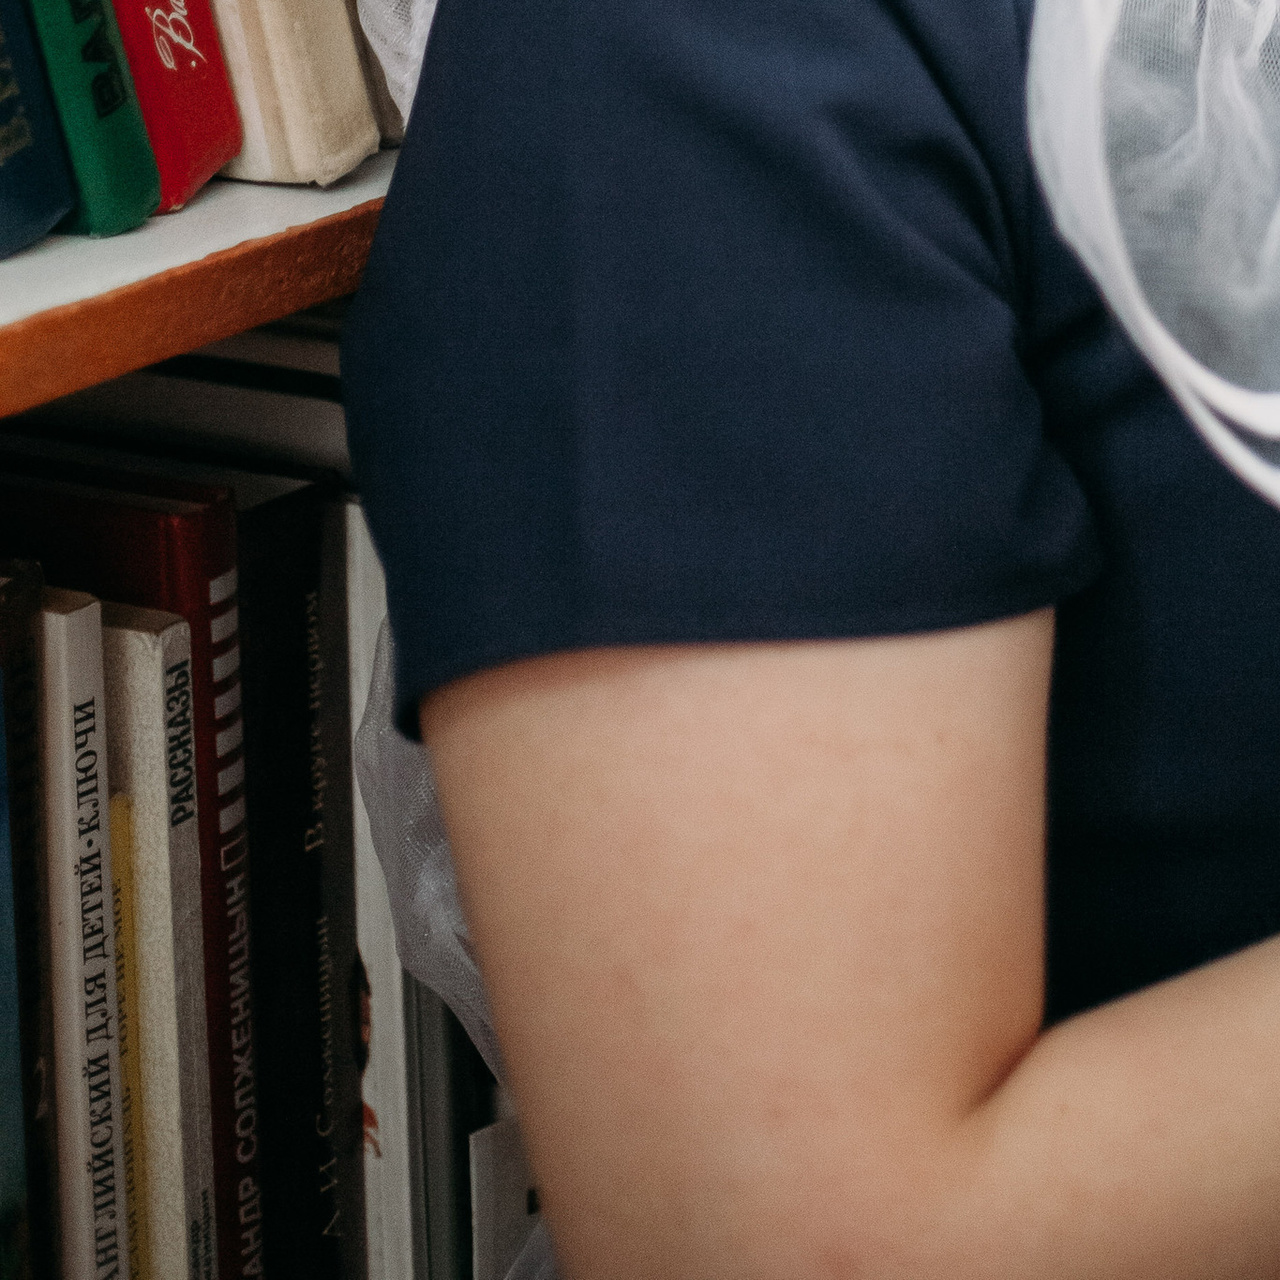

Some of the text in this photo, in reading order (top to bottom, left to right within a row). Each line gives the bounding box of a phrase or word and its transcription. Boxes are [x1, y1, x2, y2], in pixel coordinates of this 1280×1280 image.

[165, 659, 195, 827] РАССКАЗЫ
[84, 968, 114, 1047] ДЛЯ
[226, 870, 257, 1165] СОЛЖЕНИЦЫН
